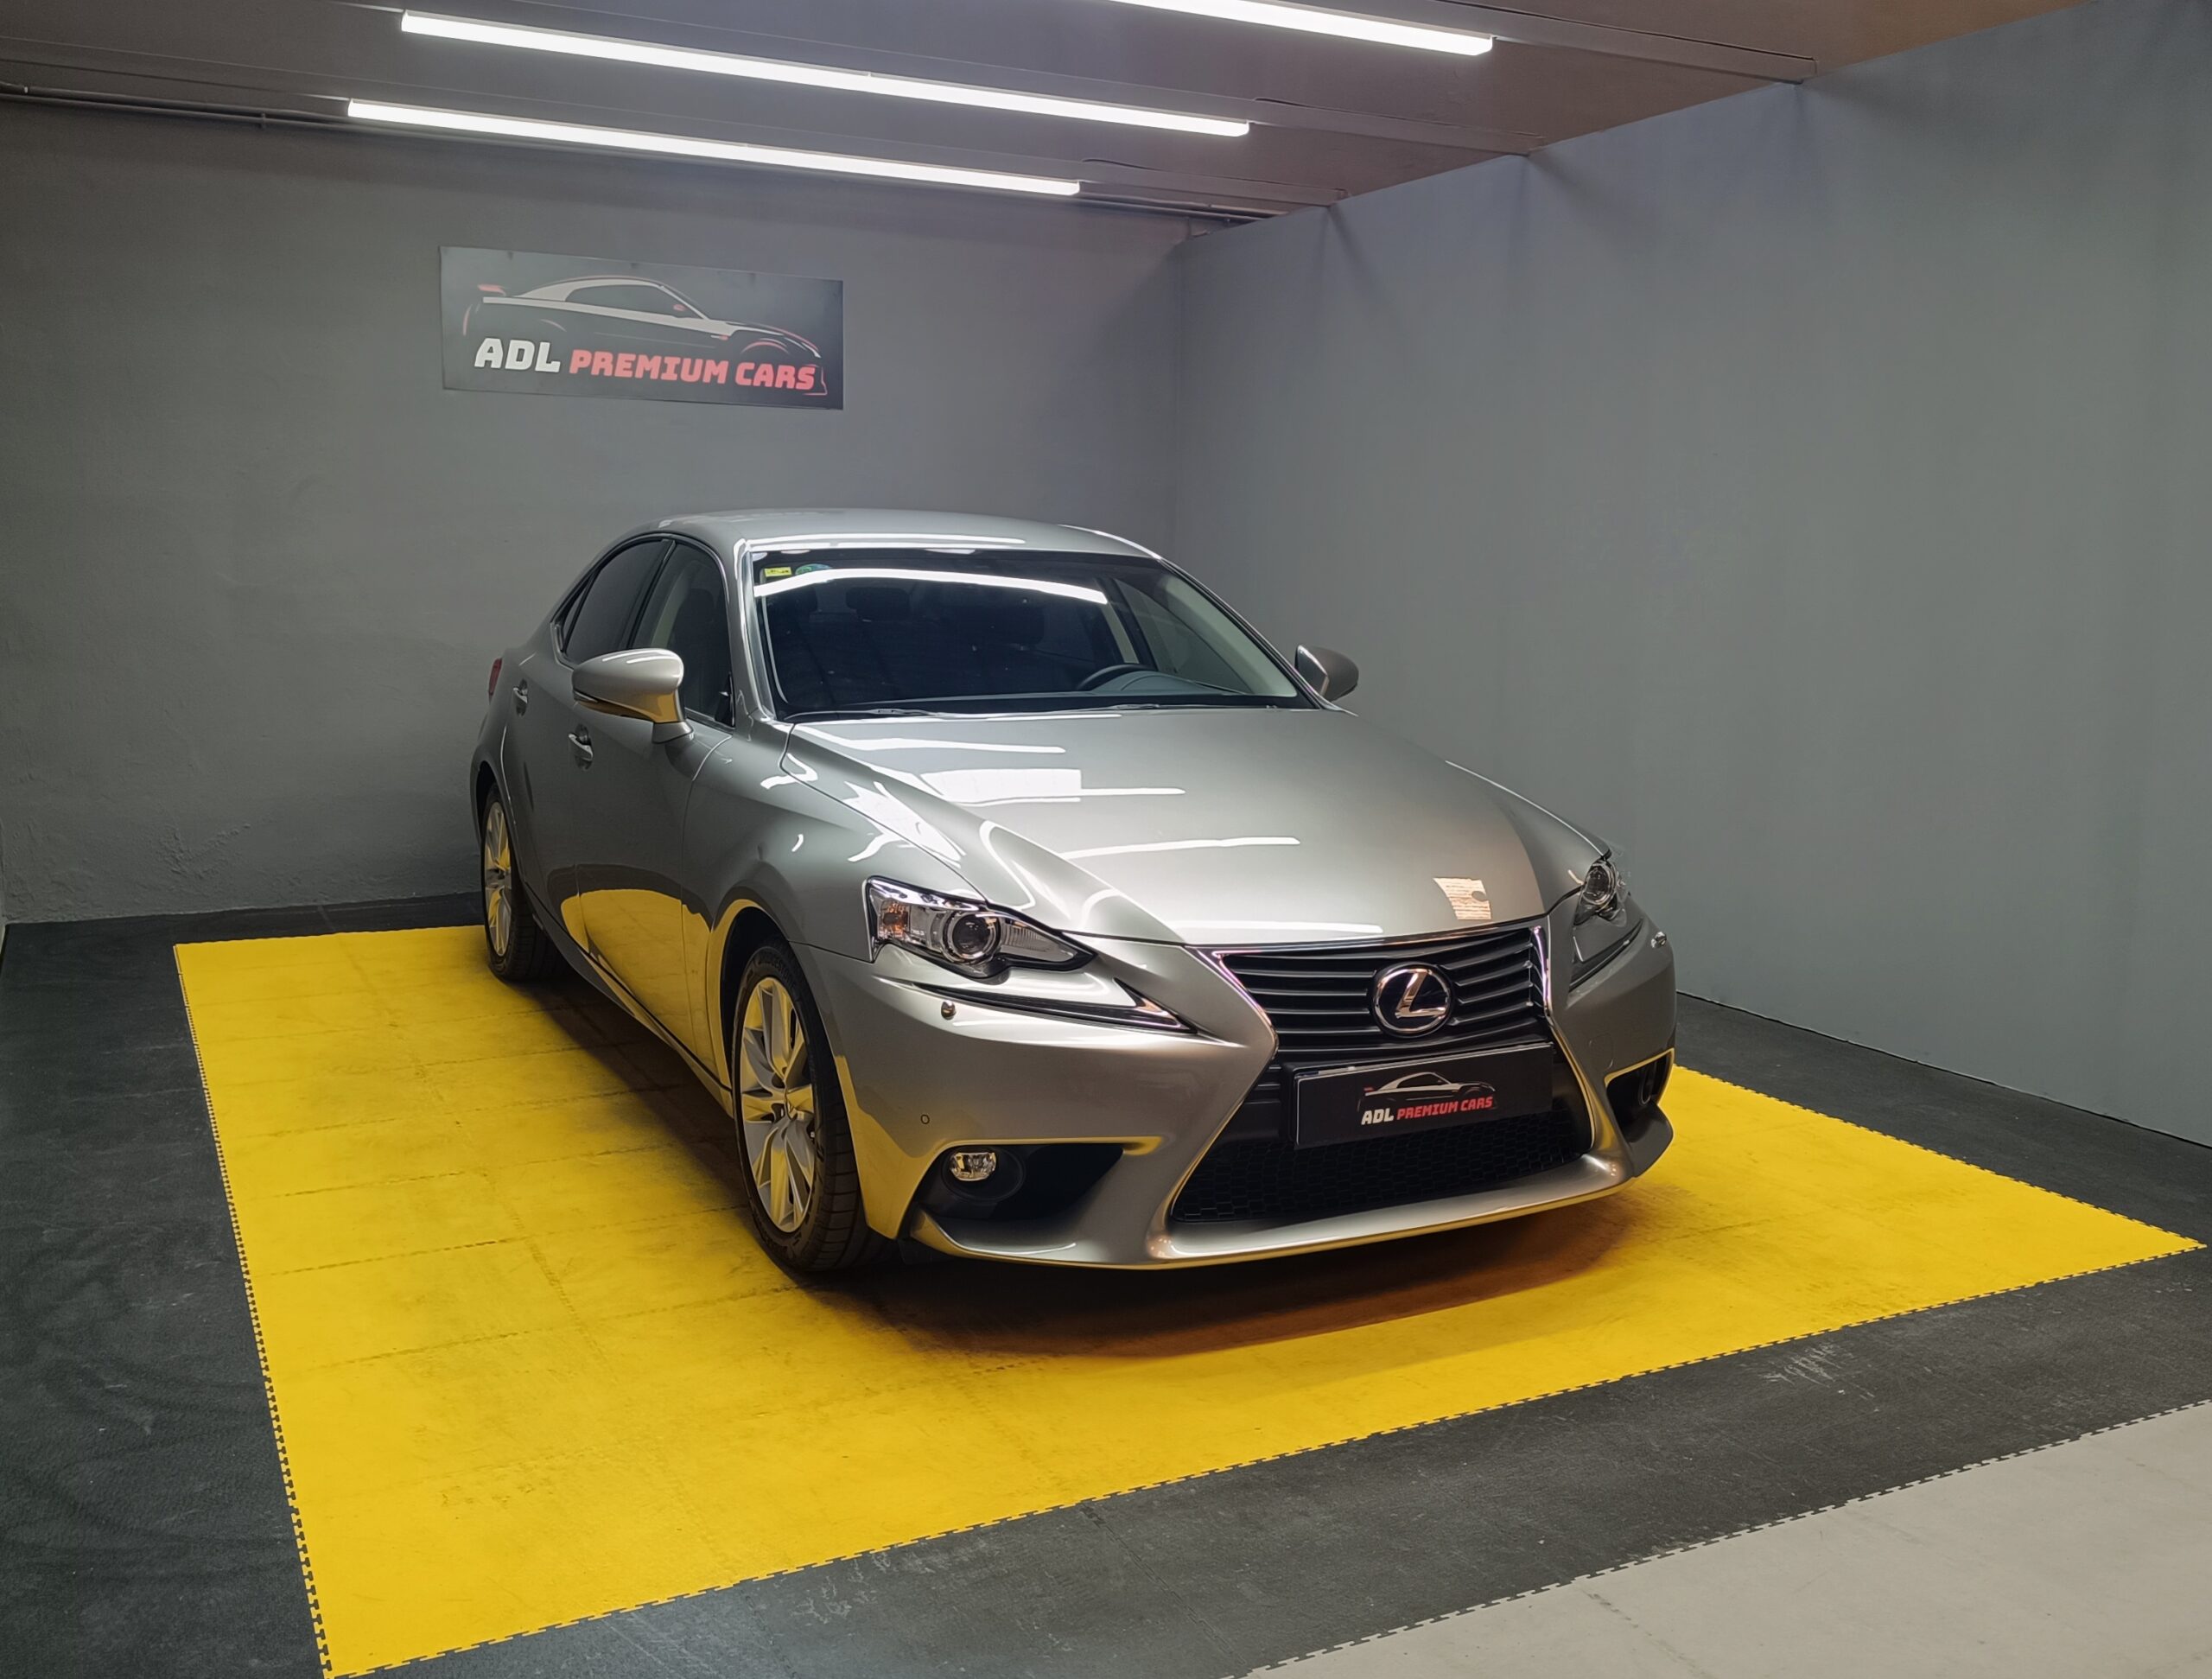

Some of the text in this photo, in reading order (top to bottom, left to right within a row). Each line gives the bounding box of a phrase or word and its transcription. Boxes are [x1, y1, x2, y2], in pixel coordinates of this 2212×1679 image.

[474, 338, 815, 390] ADL PREMIUM CARS
[1361, 1097, 1492, 1126] ADL PREMIUM CARS
